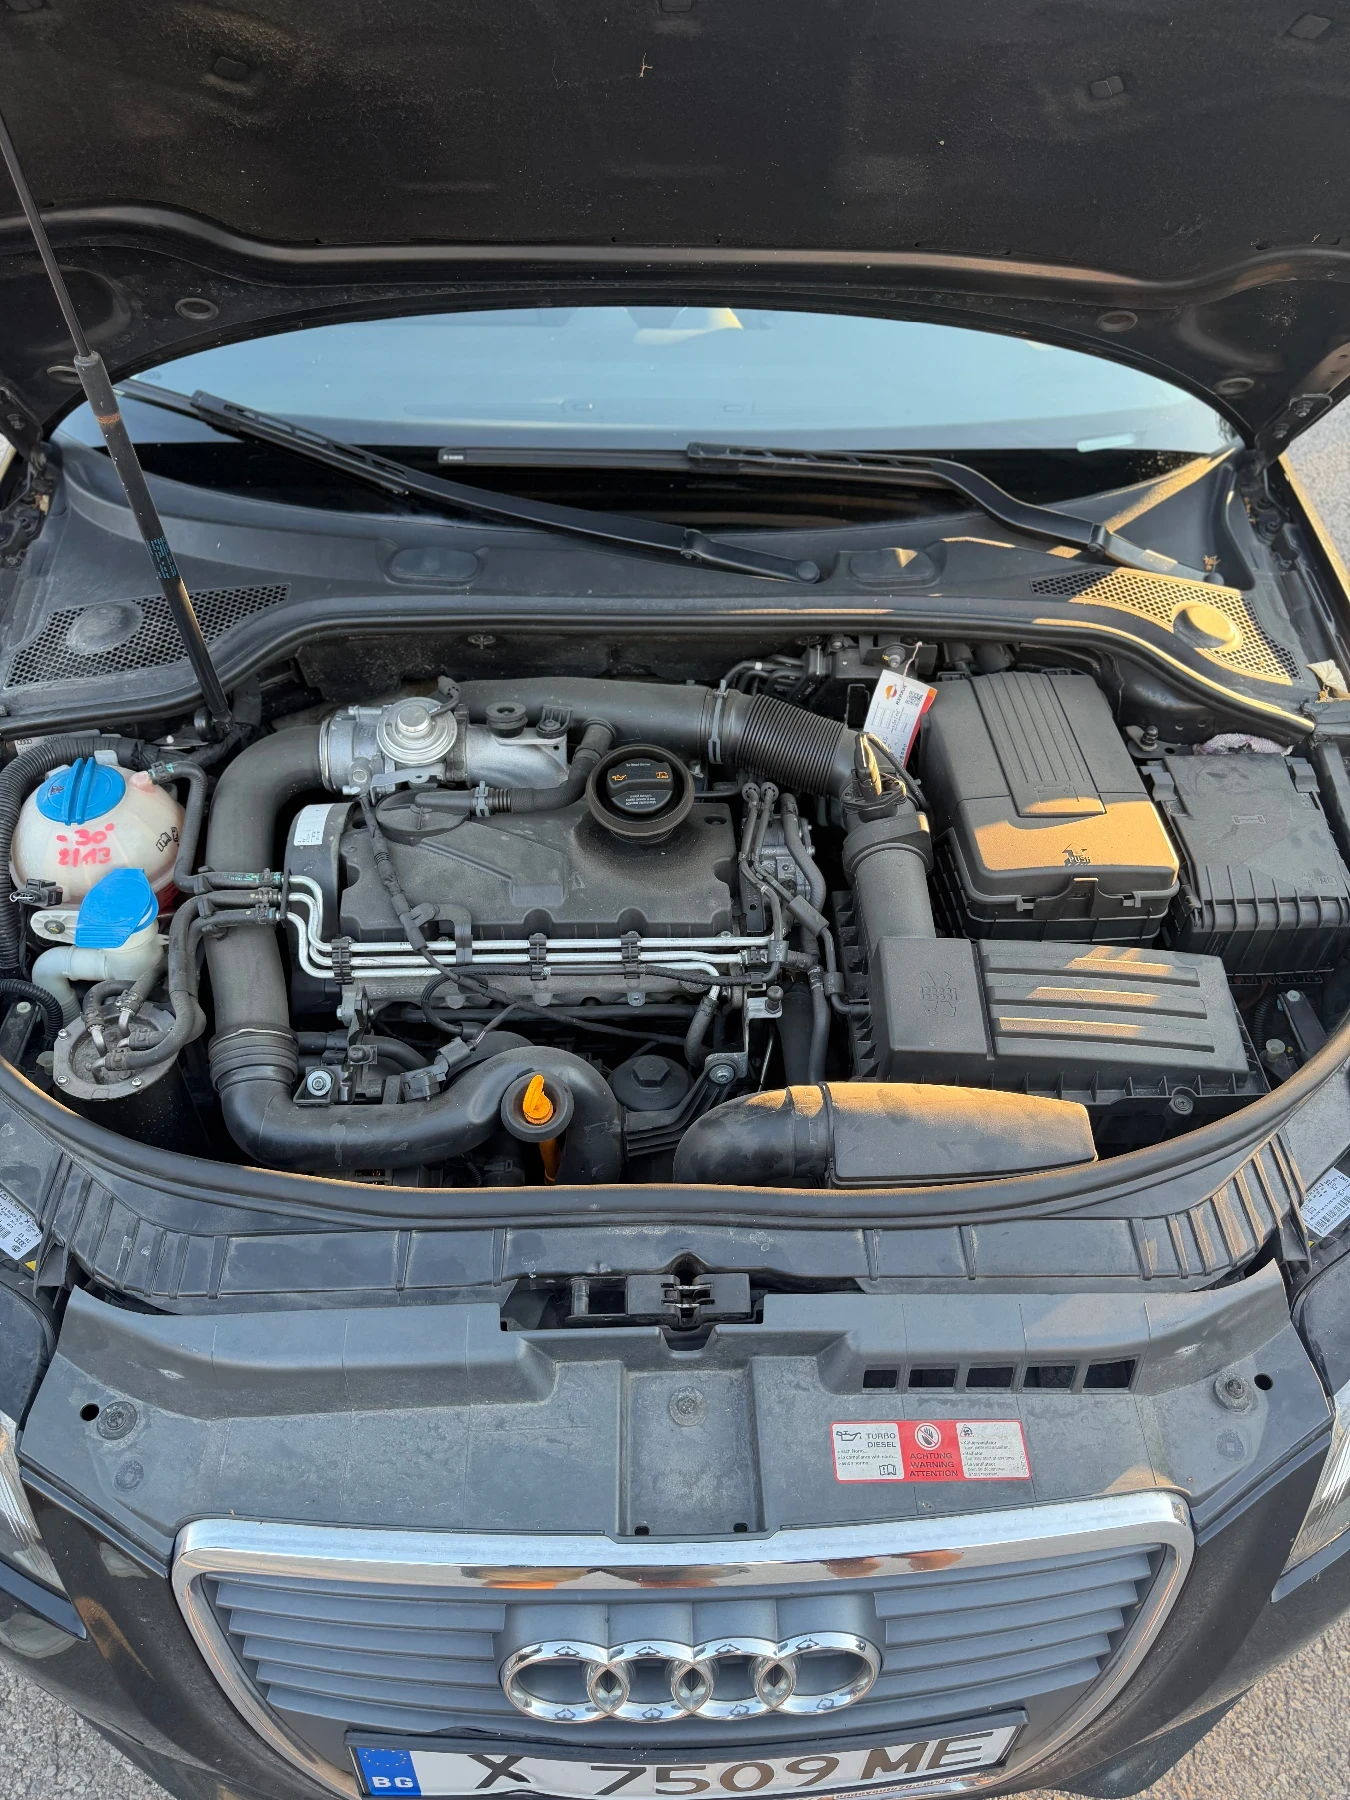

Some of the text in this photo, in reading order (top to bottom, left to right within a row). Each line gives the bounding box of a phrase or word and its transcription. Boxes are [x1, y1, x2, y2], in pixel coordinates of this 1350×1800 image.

[866, 1432, 896, 1440] TURBO
[909, 1452, 953, 1460] ACHTUNG
[910, 1461, 954, 1469] WARNING
[467, 1754, 532, 1789] X
[590, 1755, 840, 1796] 7509
[860, 1731, 994, 1781] ME
[371, 1776, 414, 1788] BG
